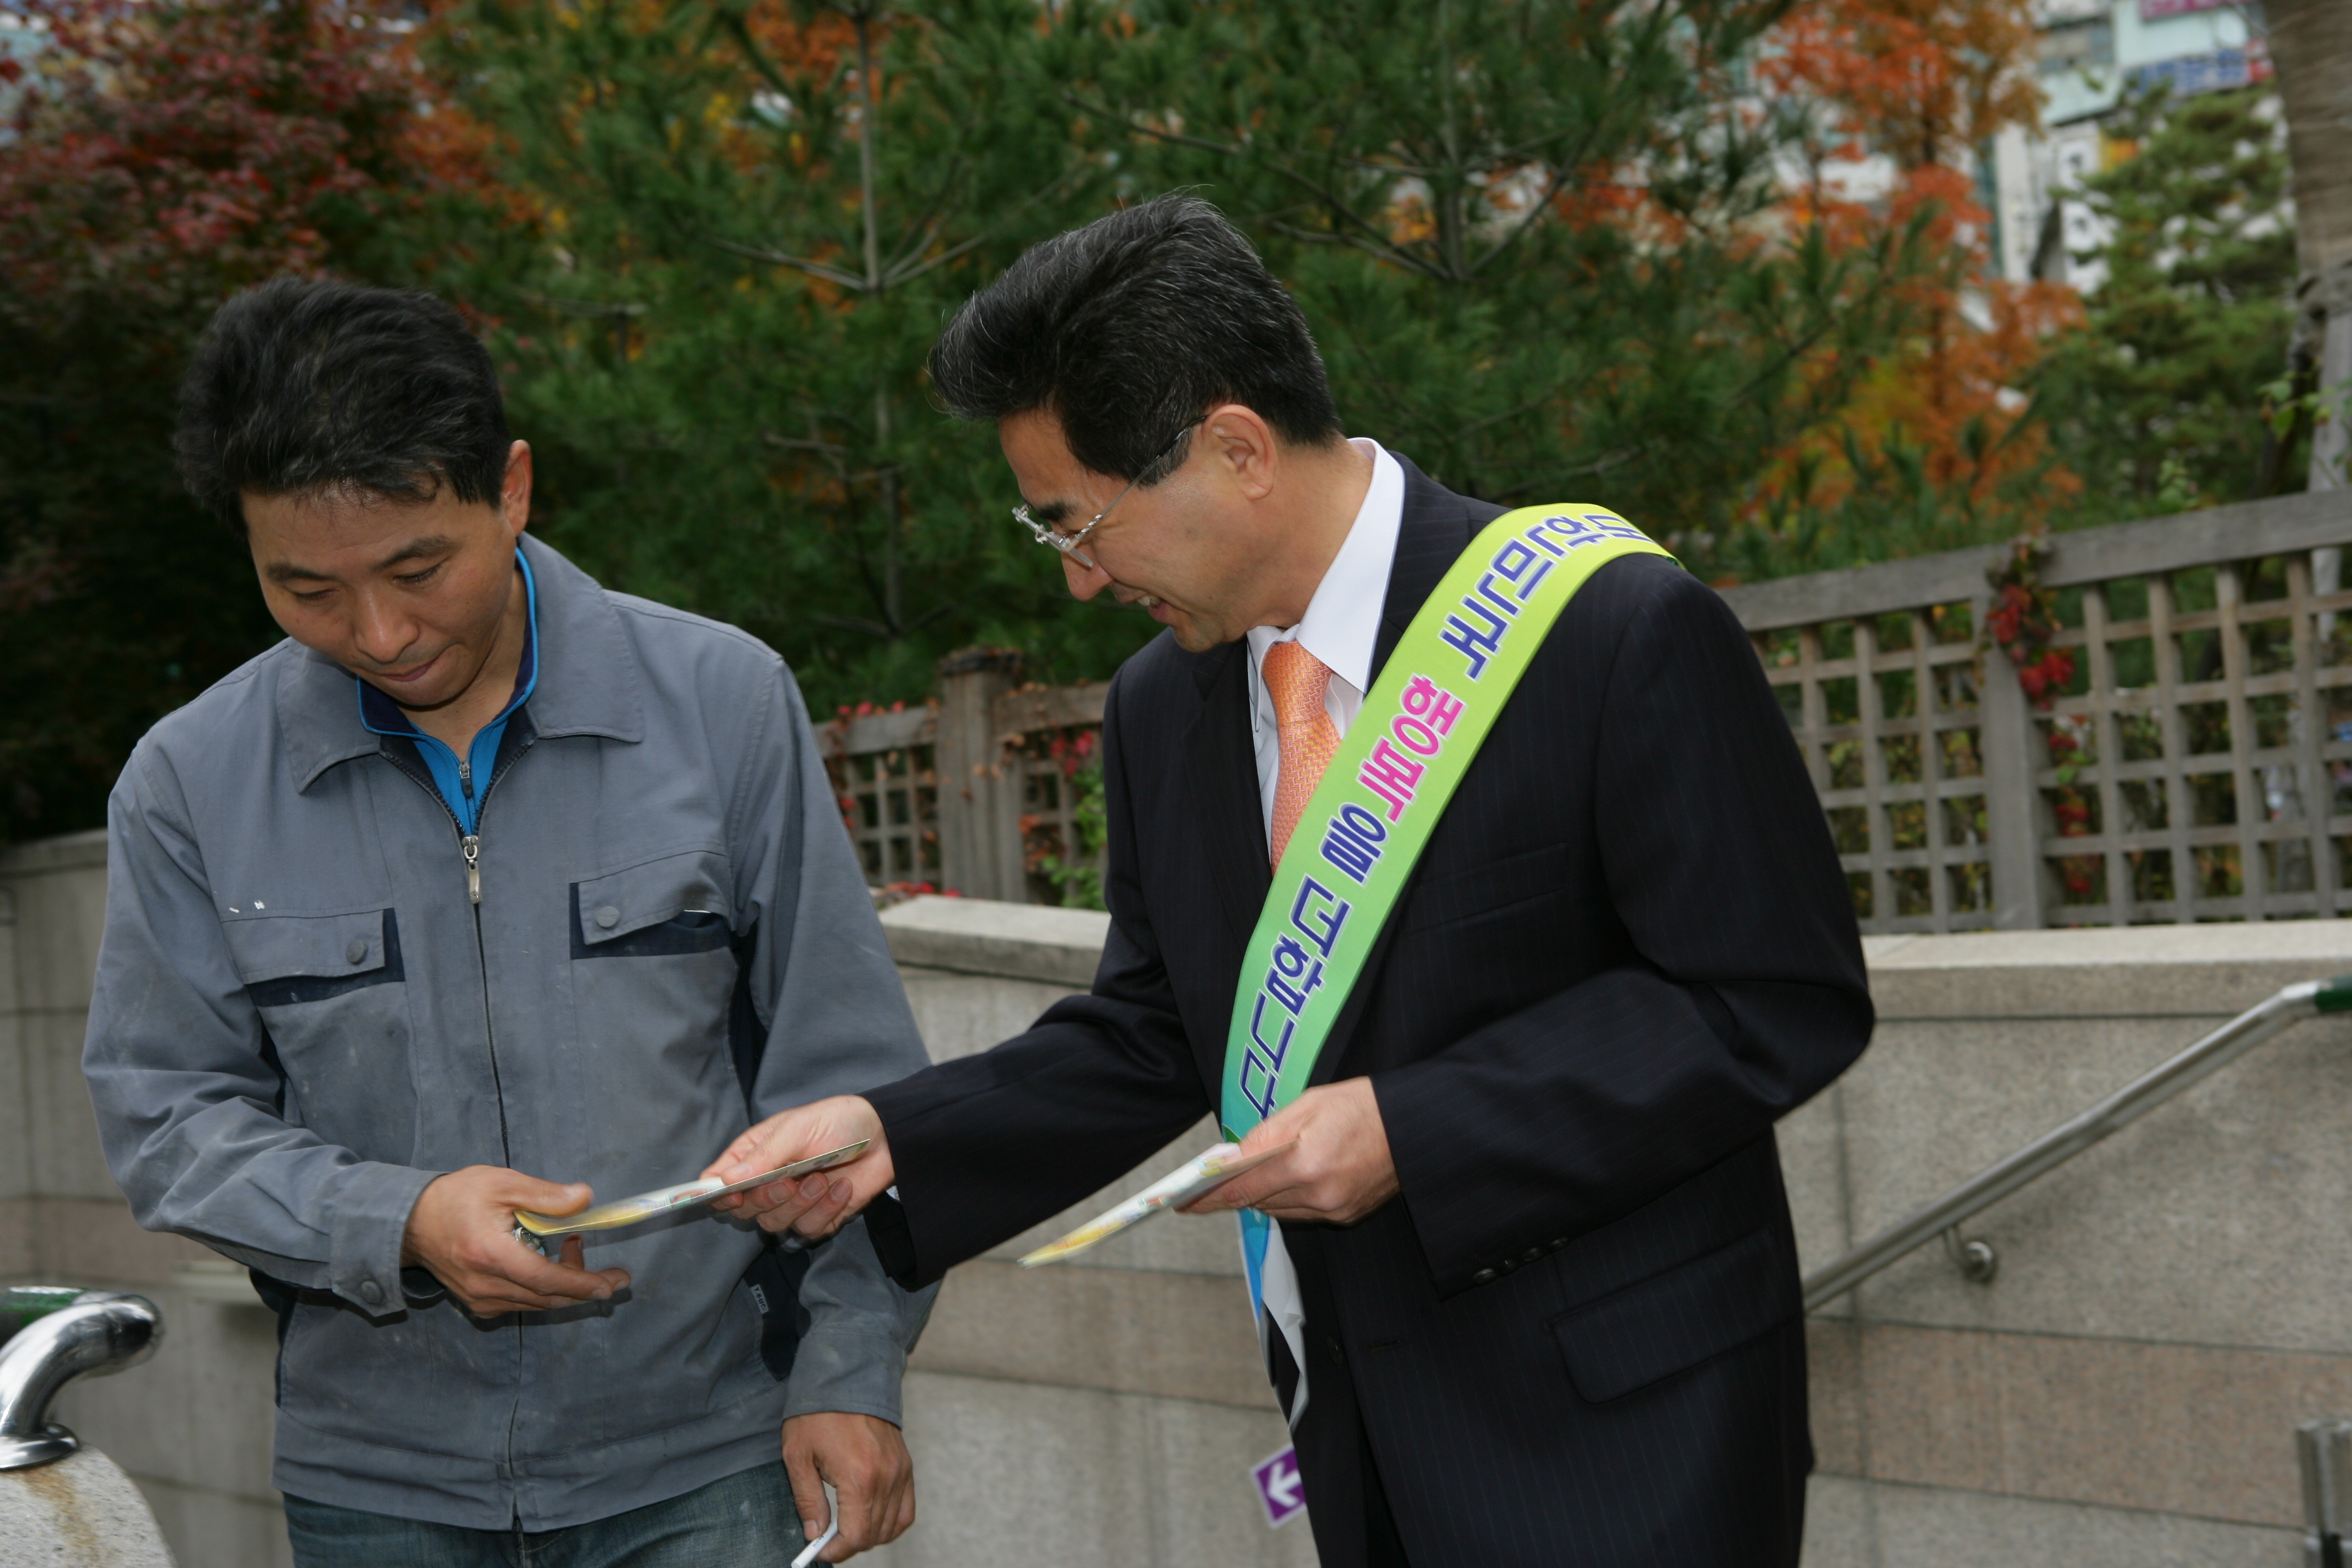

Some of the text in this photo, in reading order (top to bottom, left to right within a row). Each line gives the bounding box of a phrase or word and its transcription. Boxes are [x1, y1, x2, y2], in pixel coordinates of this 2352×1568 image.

[1239, 514, 1657, 1124] 대한민국 행복을 더합니다
